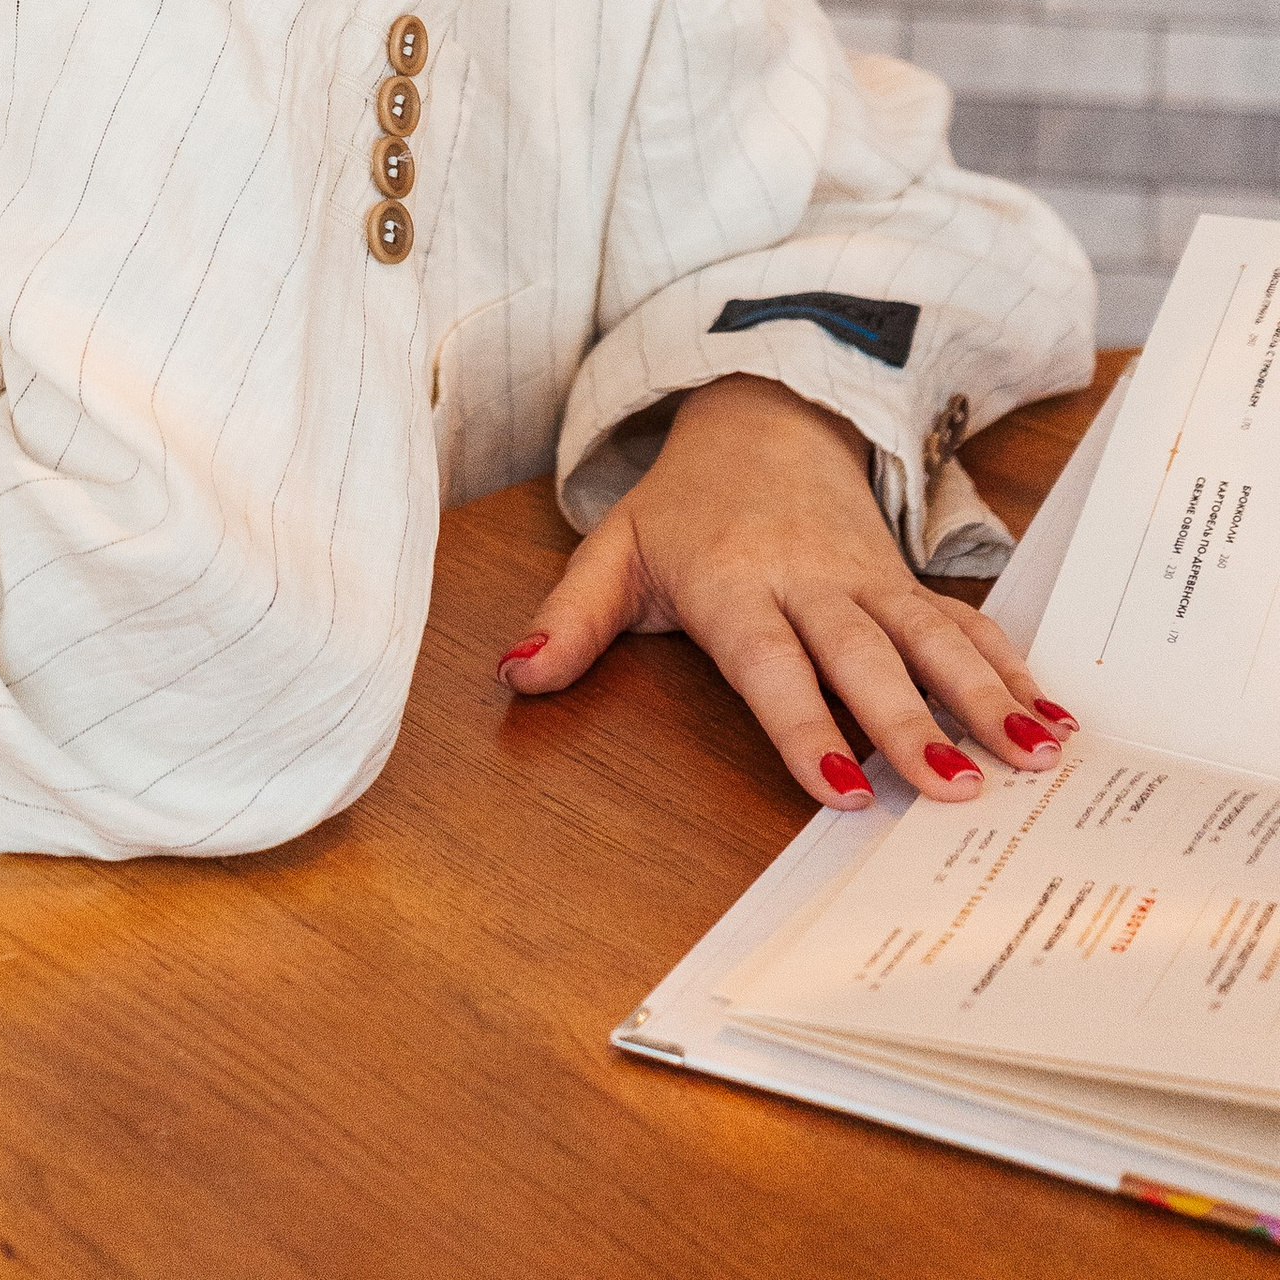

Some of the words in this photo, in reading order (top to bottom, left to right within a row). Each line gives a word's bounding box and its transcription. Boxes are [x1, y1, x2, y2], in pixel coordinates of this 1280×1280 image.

[1250, 358, 1273, 408] ТРЮФЕЛЕМ
[1185, 476, 1206, 515] СВЕЖИЕ
[1203, 480, 1229, 538] КАРТОФЕЛЬ
[1225, 485, 1252, 544] БРОККОЛЛИ
[1173, 516, 1193, 555] ОВОЩИ
[1163, 565, 1177, 580] 230
[1175, 539, 1210, 619] ПО-ДЕРЕВЕНСКИ
[1217, 553, 1230, 570] 260
[1167, 630, 1179, 644] 170
